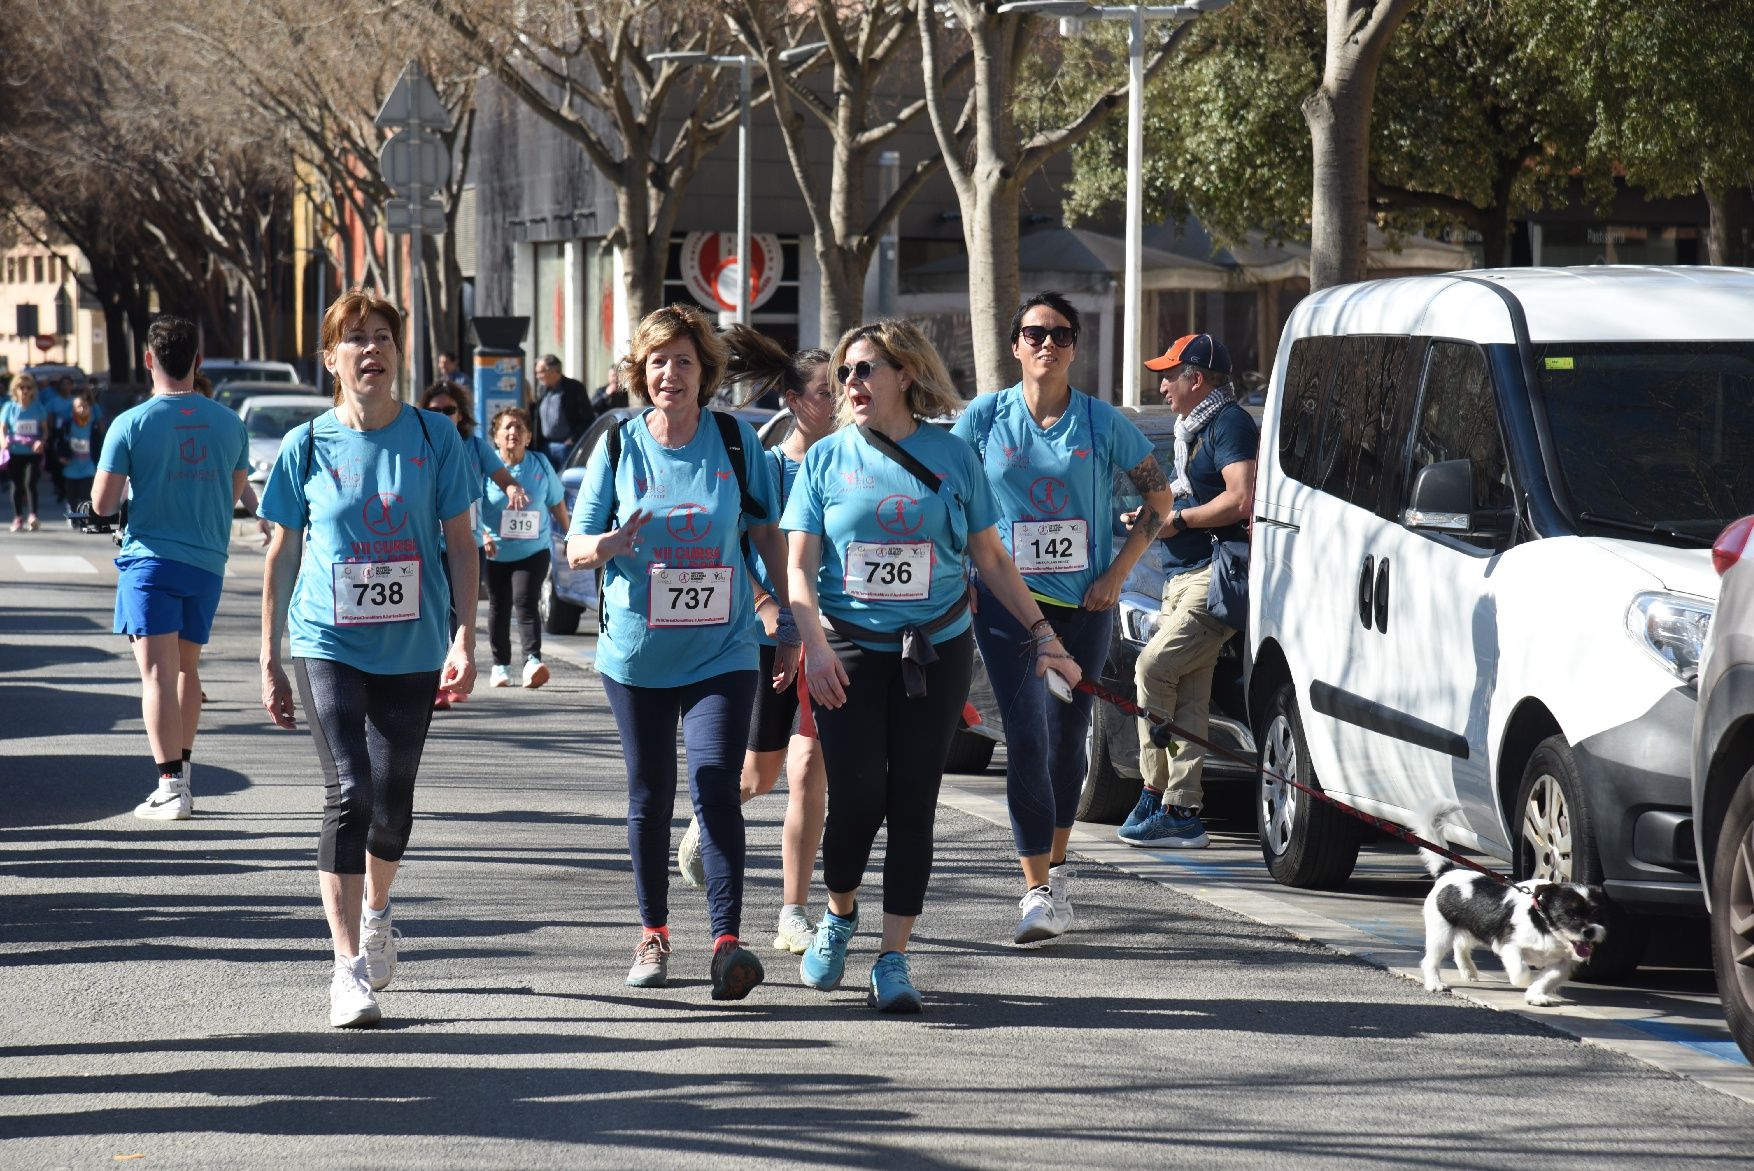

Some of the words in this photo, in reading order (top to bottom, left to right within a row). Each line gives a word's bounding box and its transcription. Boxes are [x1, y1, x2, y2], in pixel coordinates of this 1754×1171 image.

[509, 519, 533, 531] 319
[653, 547, 673, 561] VII
[674, 546, 721, 560] CURSA
[1031, 537, 1073, 559] 142
[865, 561, 912, 585] 736
[352, 581, 404, 607] 738
[668, 586, 715, 610] 737
